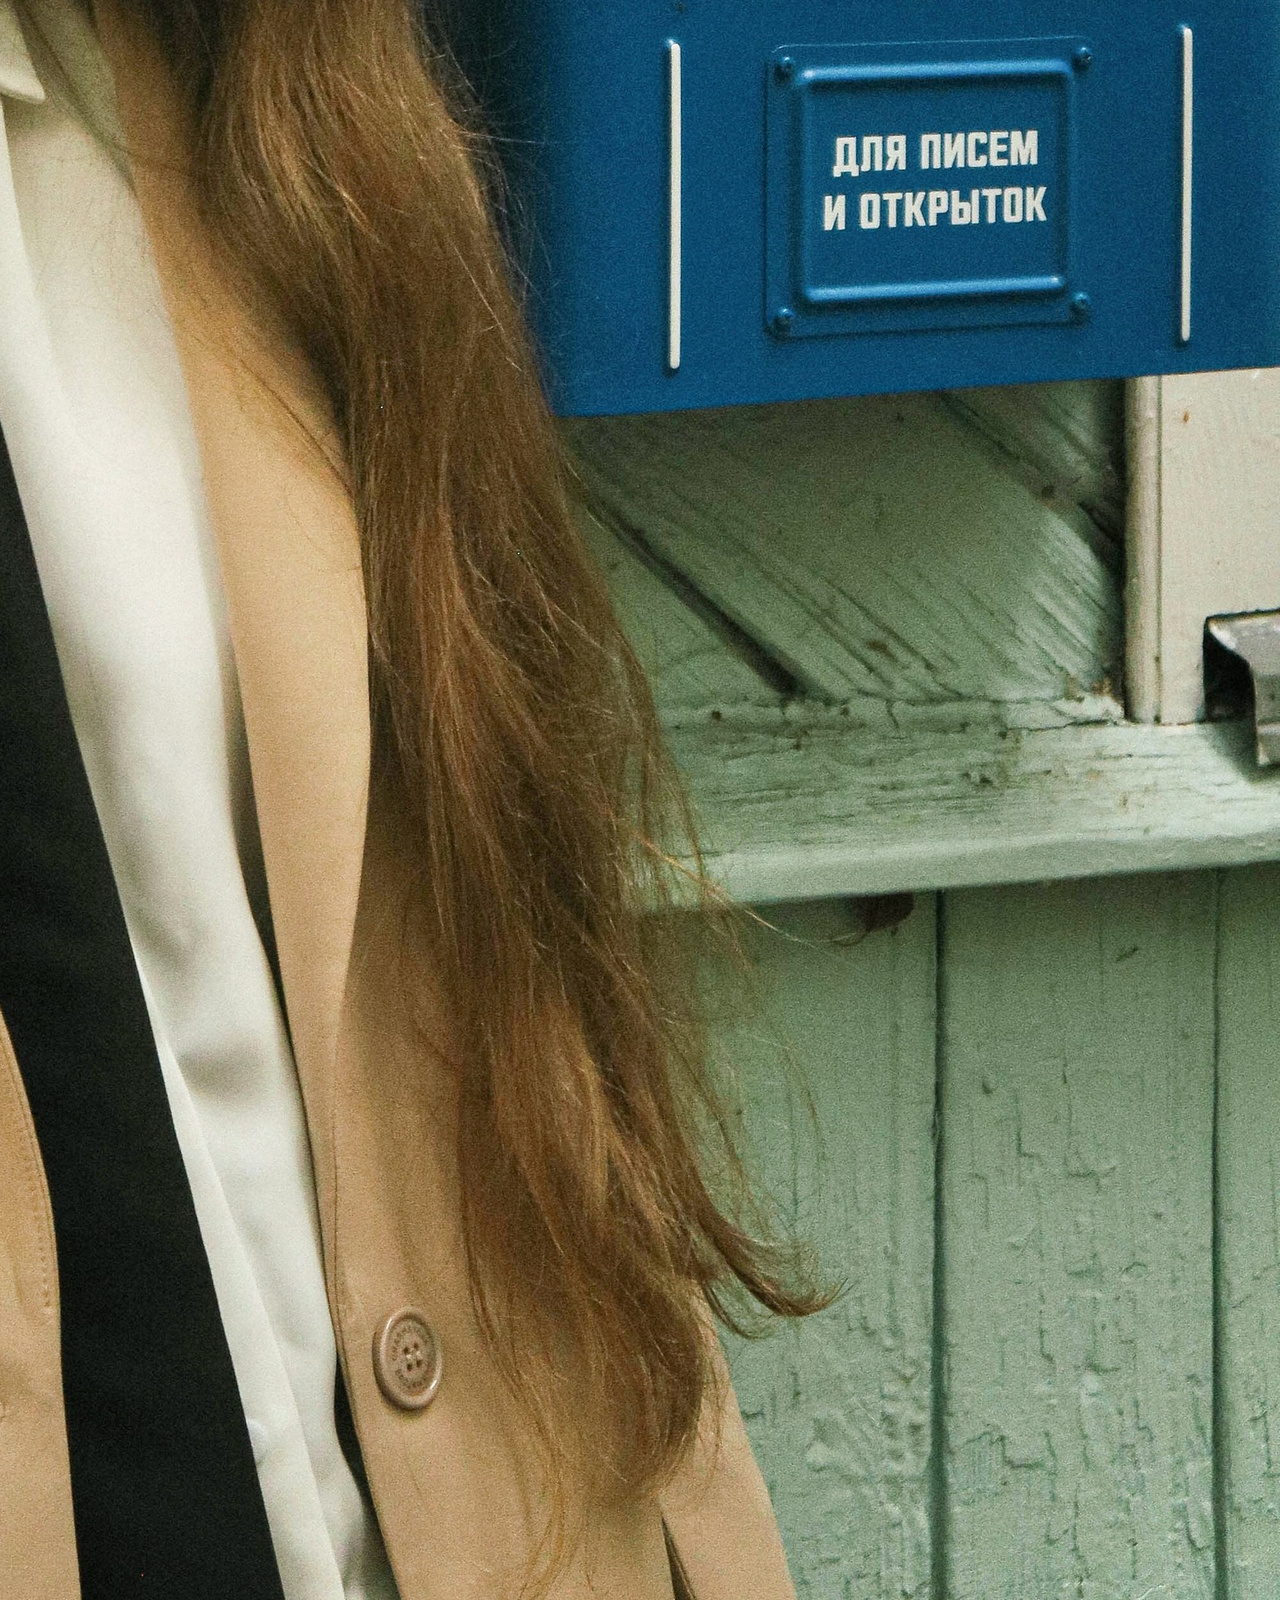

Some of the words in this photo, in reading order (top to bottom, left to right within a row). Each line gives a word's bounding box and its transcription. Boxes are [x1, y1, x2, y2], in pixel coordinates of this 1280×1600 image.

[833, 136, 906, 177] ДЛЯ
[921, 130, 1038, 169] ПИСЕМ
[823, 195, 846, 231] И
[860, 187, 1048, 229] ОТКРЫТОК
